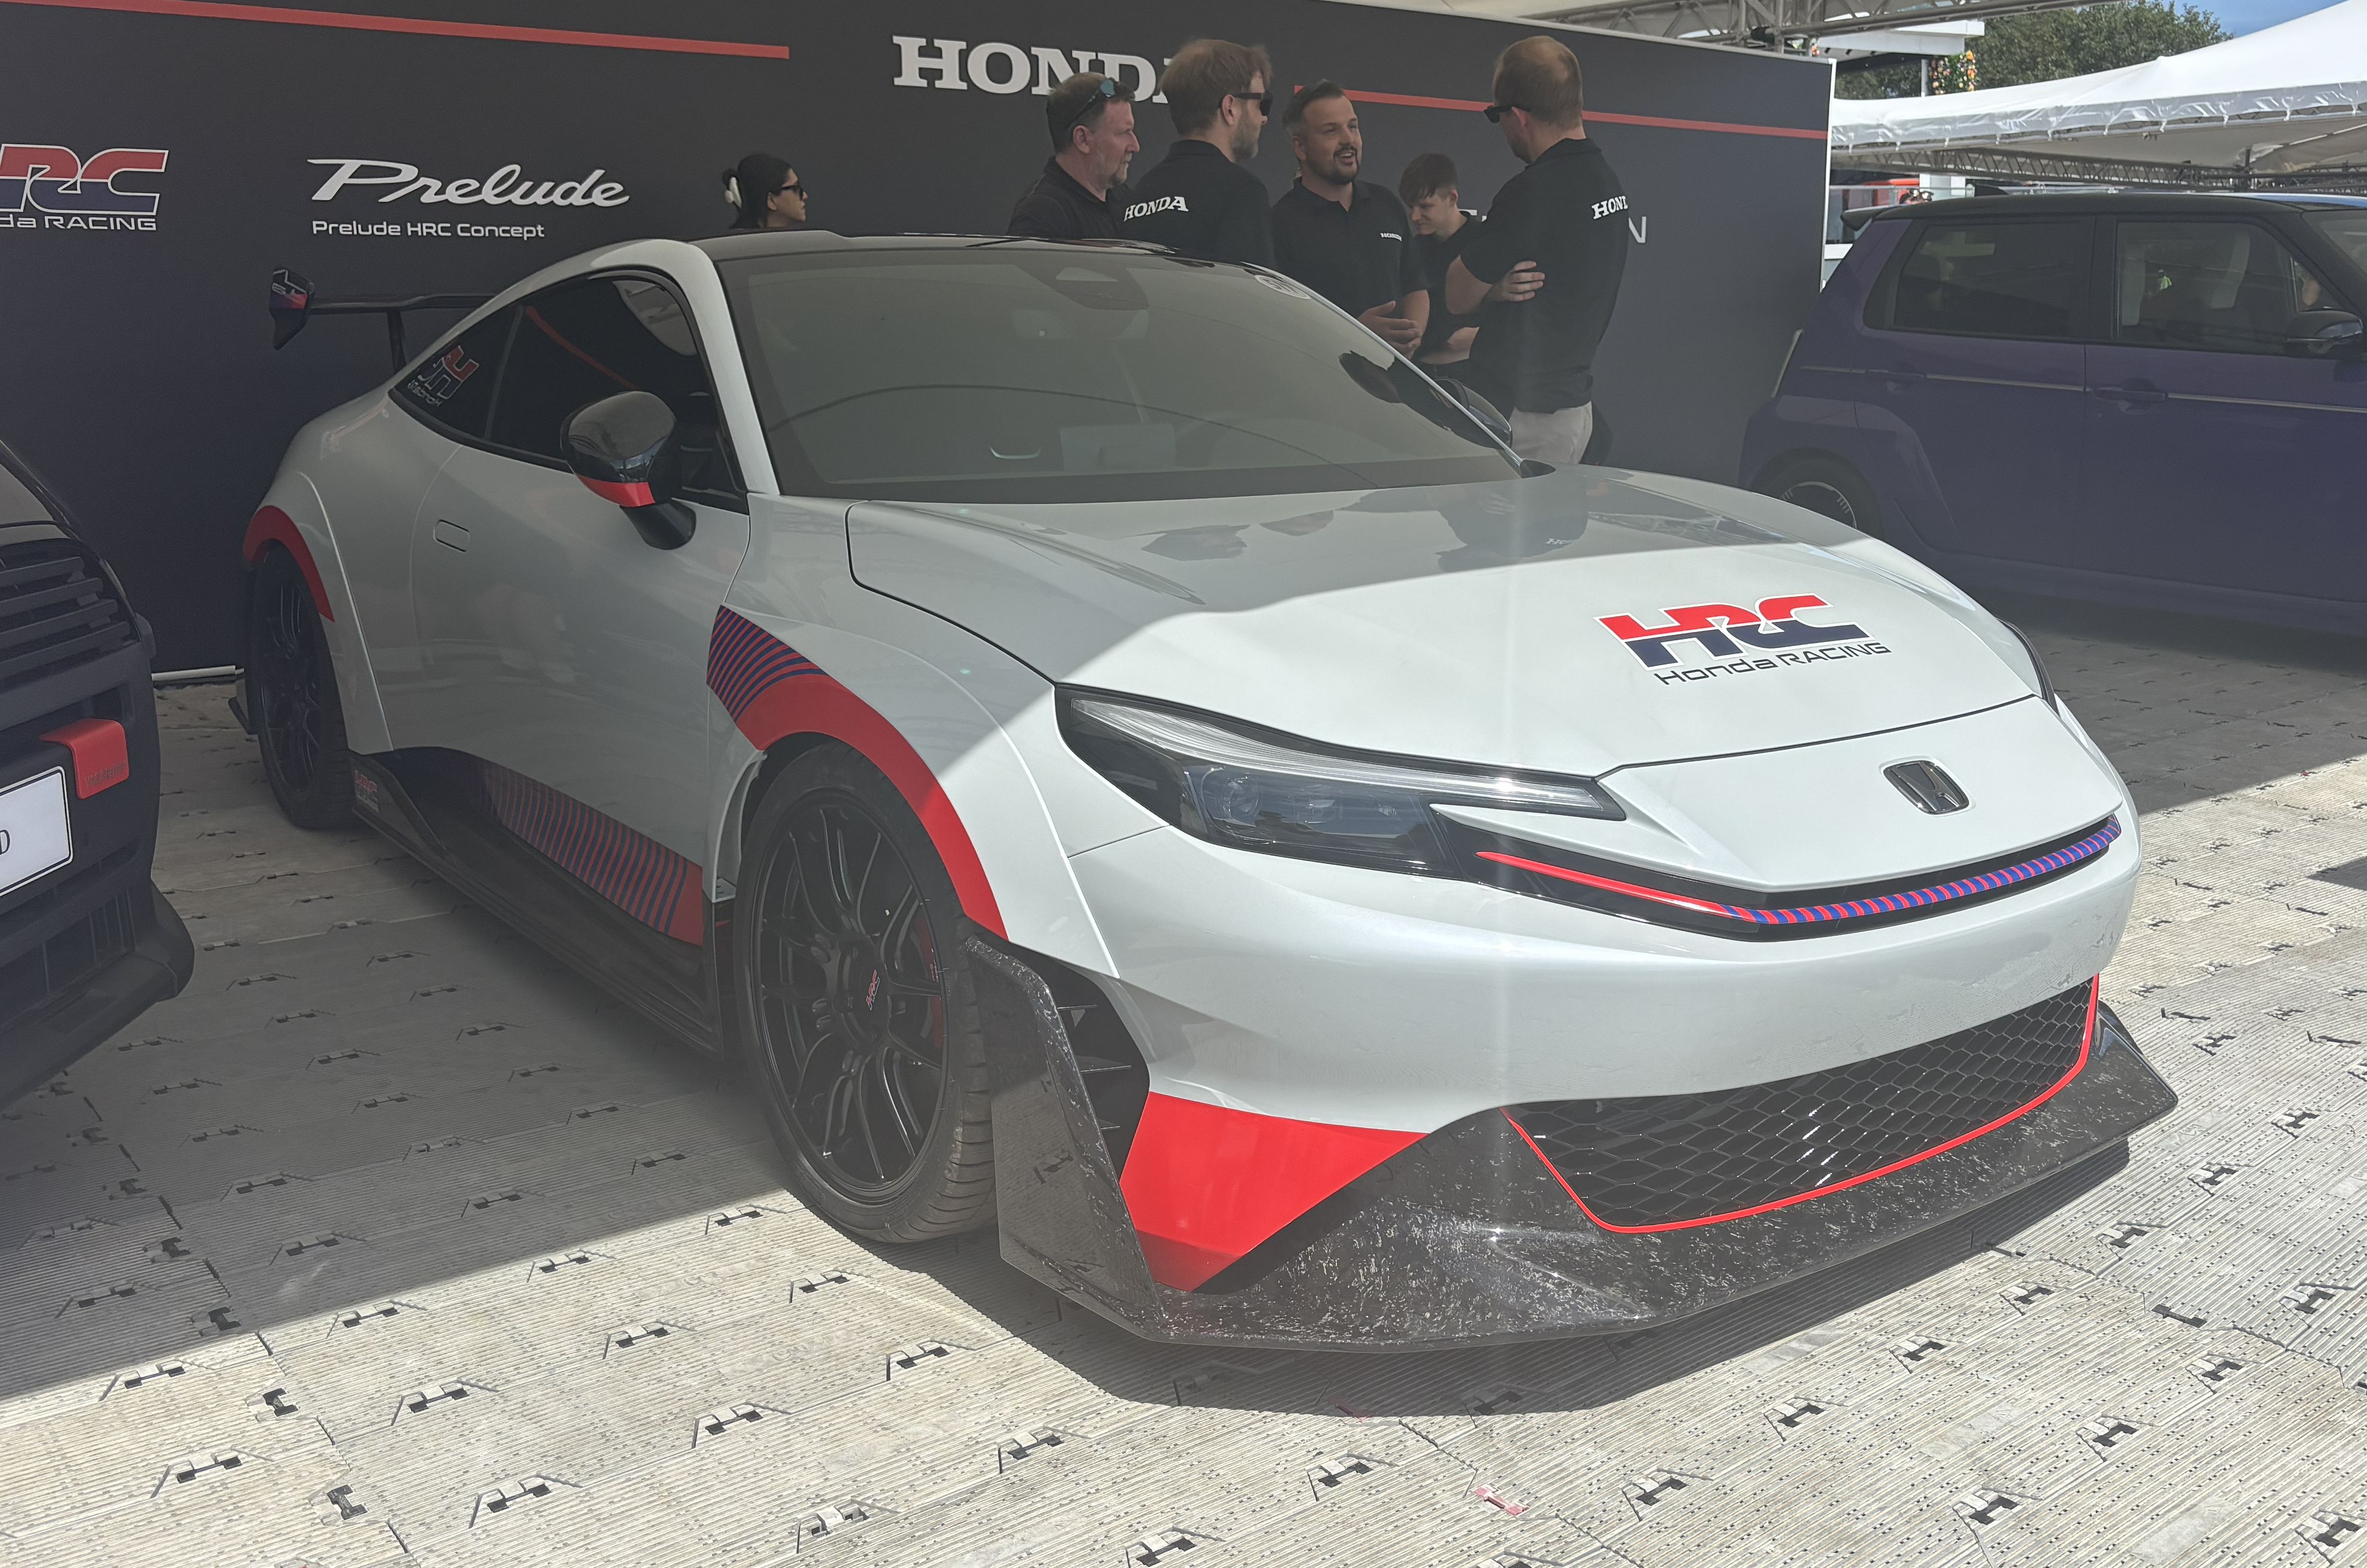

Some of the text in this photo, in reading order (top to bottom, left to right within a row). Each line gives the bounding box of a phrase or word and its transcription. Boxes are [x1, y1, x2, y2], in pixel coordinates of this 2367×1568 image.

[892, 35, 1171, 104] HOND
[0, 144, 169, 215] RC
[307, 159, 630, 207] Prelude
[44, 215, 156, 230] RACING
[313, 221, 545, 241] Prelude HRC Concept
[1124, 196, 1189, 222] HONDA
[1594, 593, 1875, 670] HRC
[1654, 642, 1892, 686] Honda RACING
